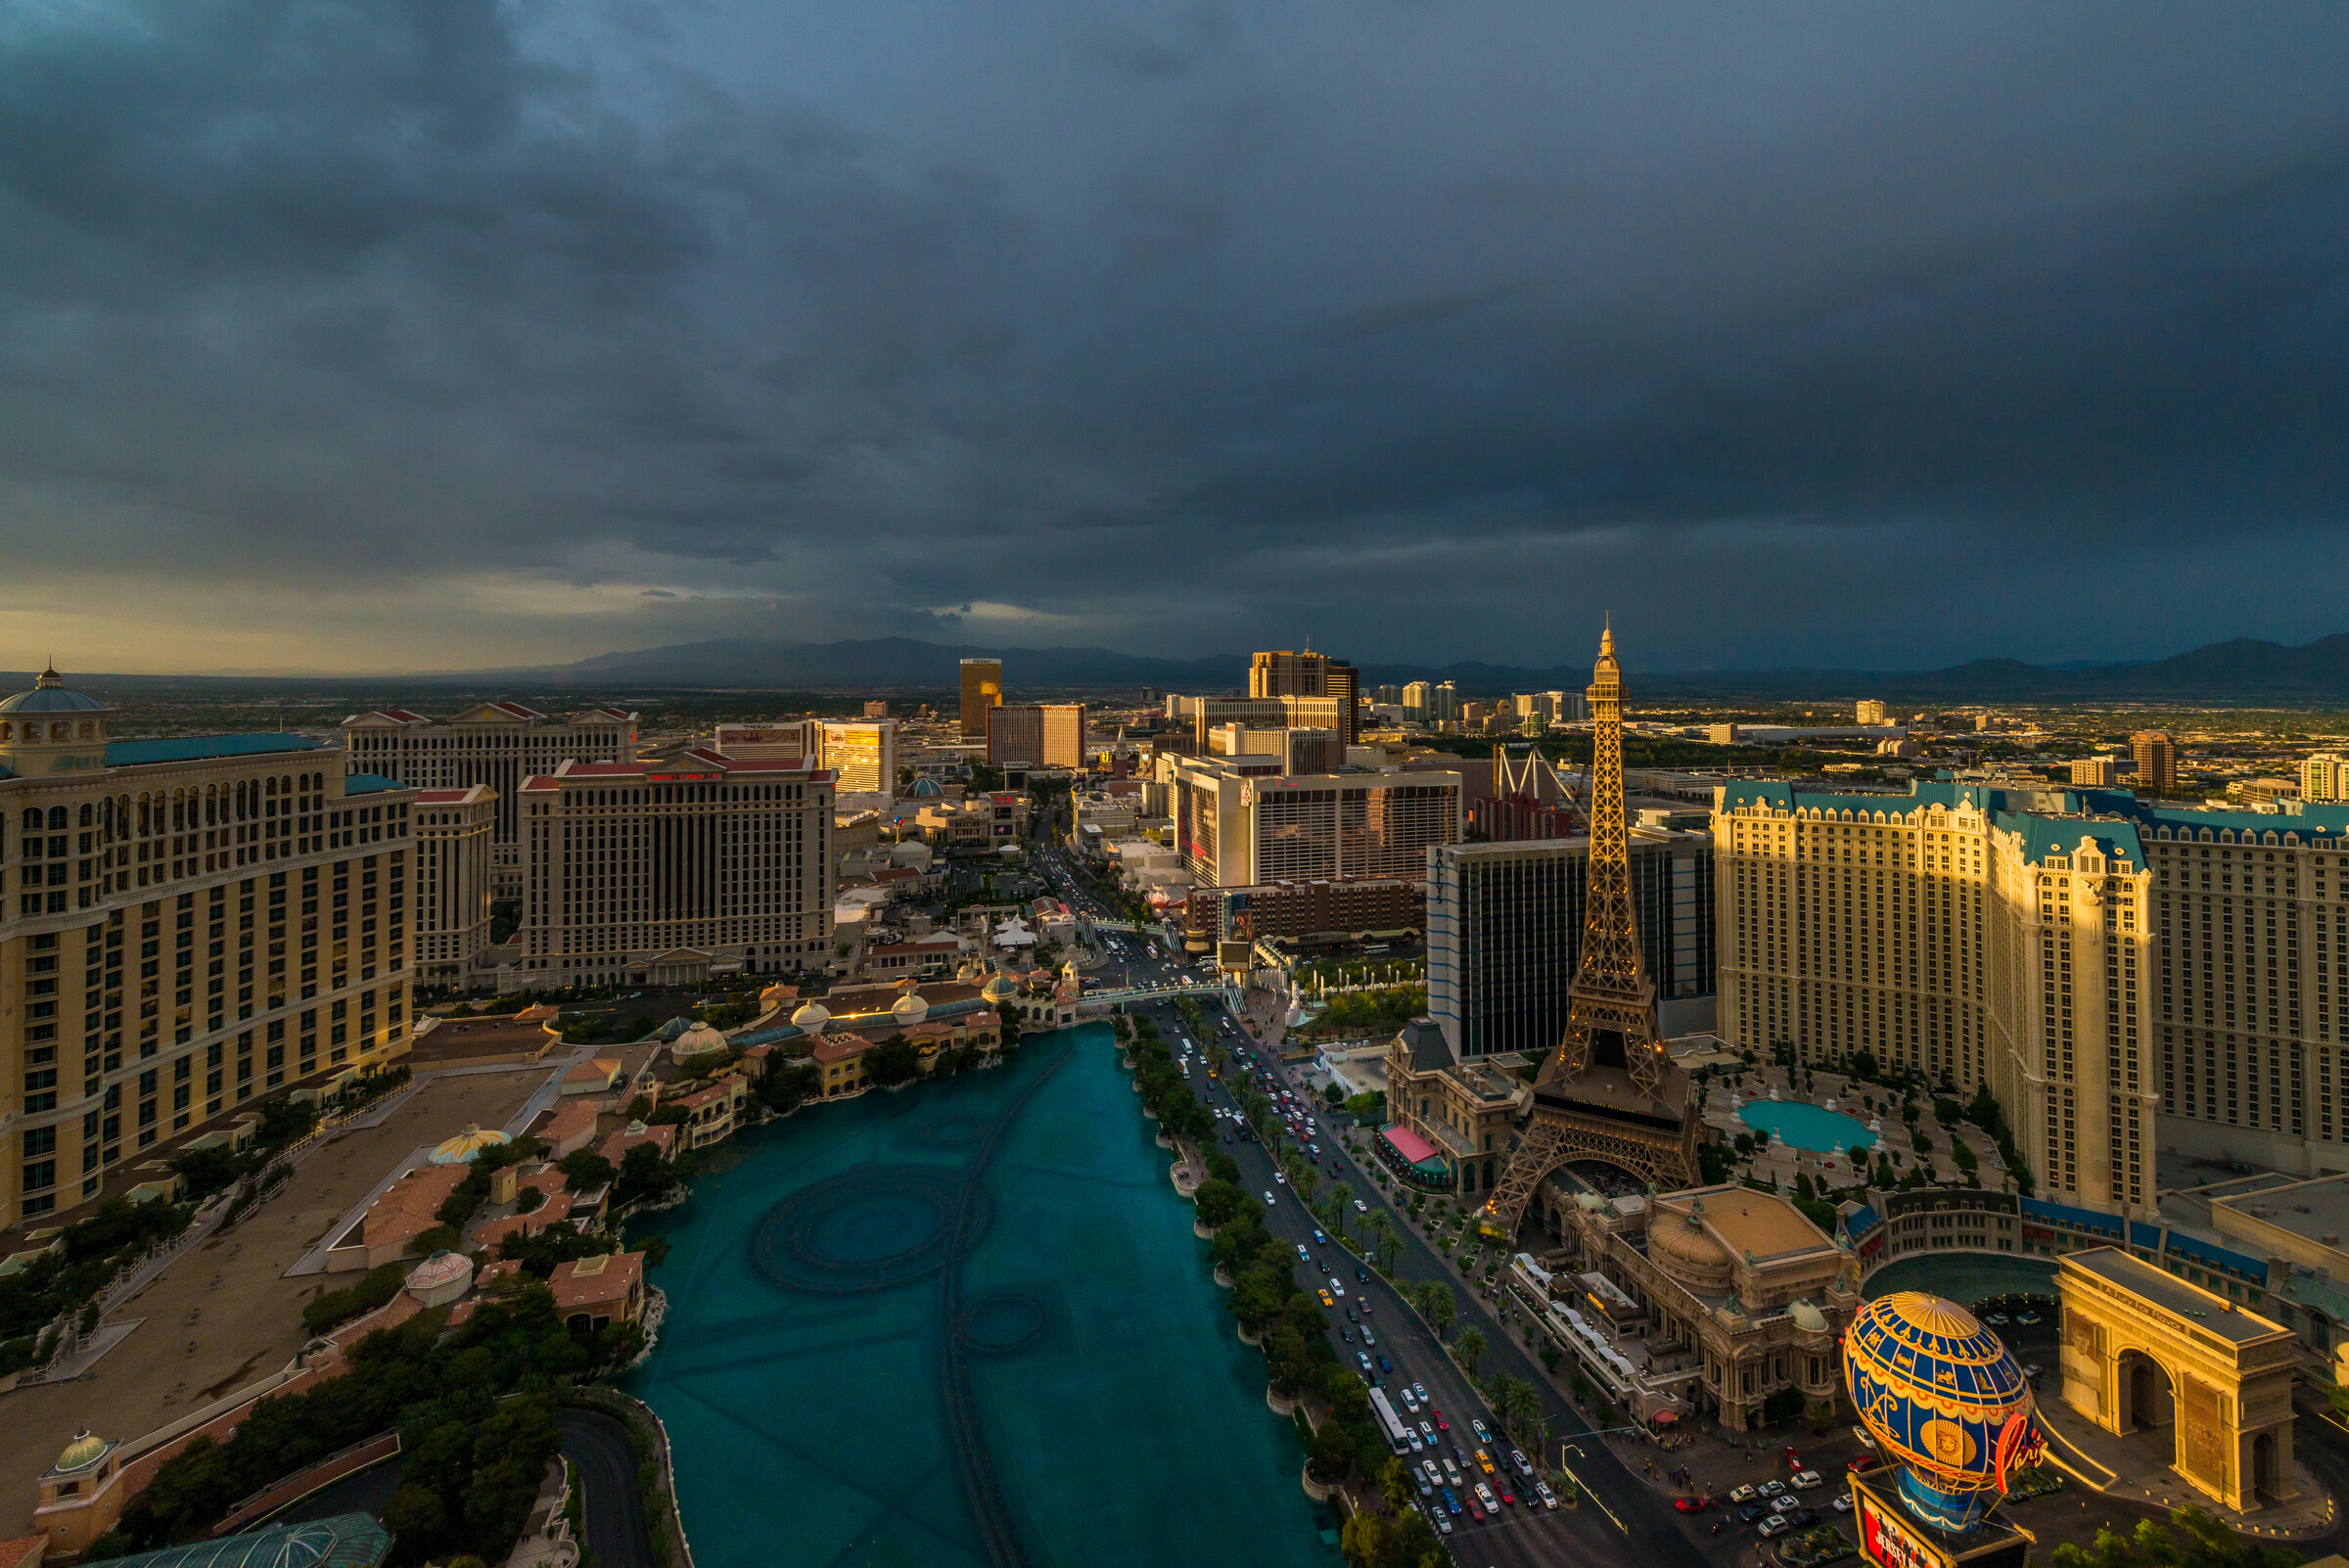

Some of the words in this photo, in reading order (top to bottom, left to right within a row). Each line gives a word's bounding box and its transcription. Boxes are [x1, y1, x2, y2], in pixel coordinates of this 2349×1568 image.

[2104, 1286, 2113, 1295] A
[2114, 1290, 2133, 1306] Fury
[2135, 1300, 2149, 1315] For
[2151, 1309, 2182, 1331] Flavor
[1996, 1411, 2049, 1495] Paris
[1875, 1530, 1907, 1567] JERSEY
